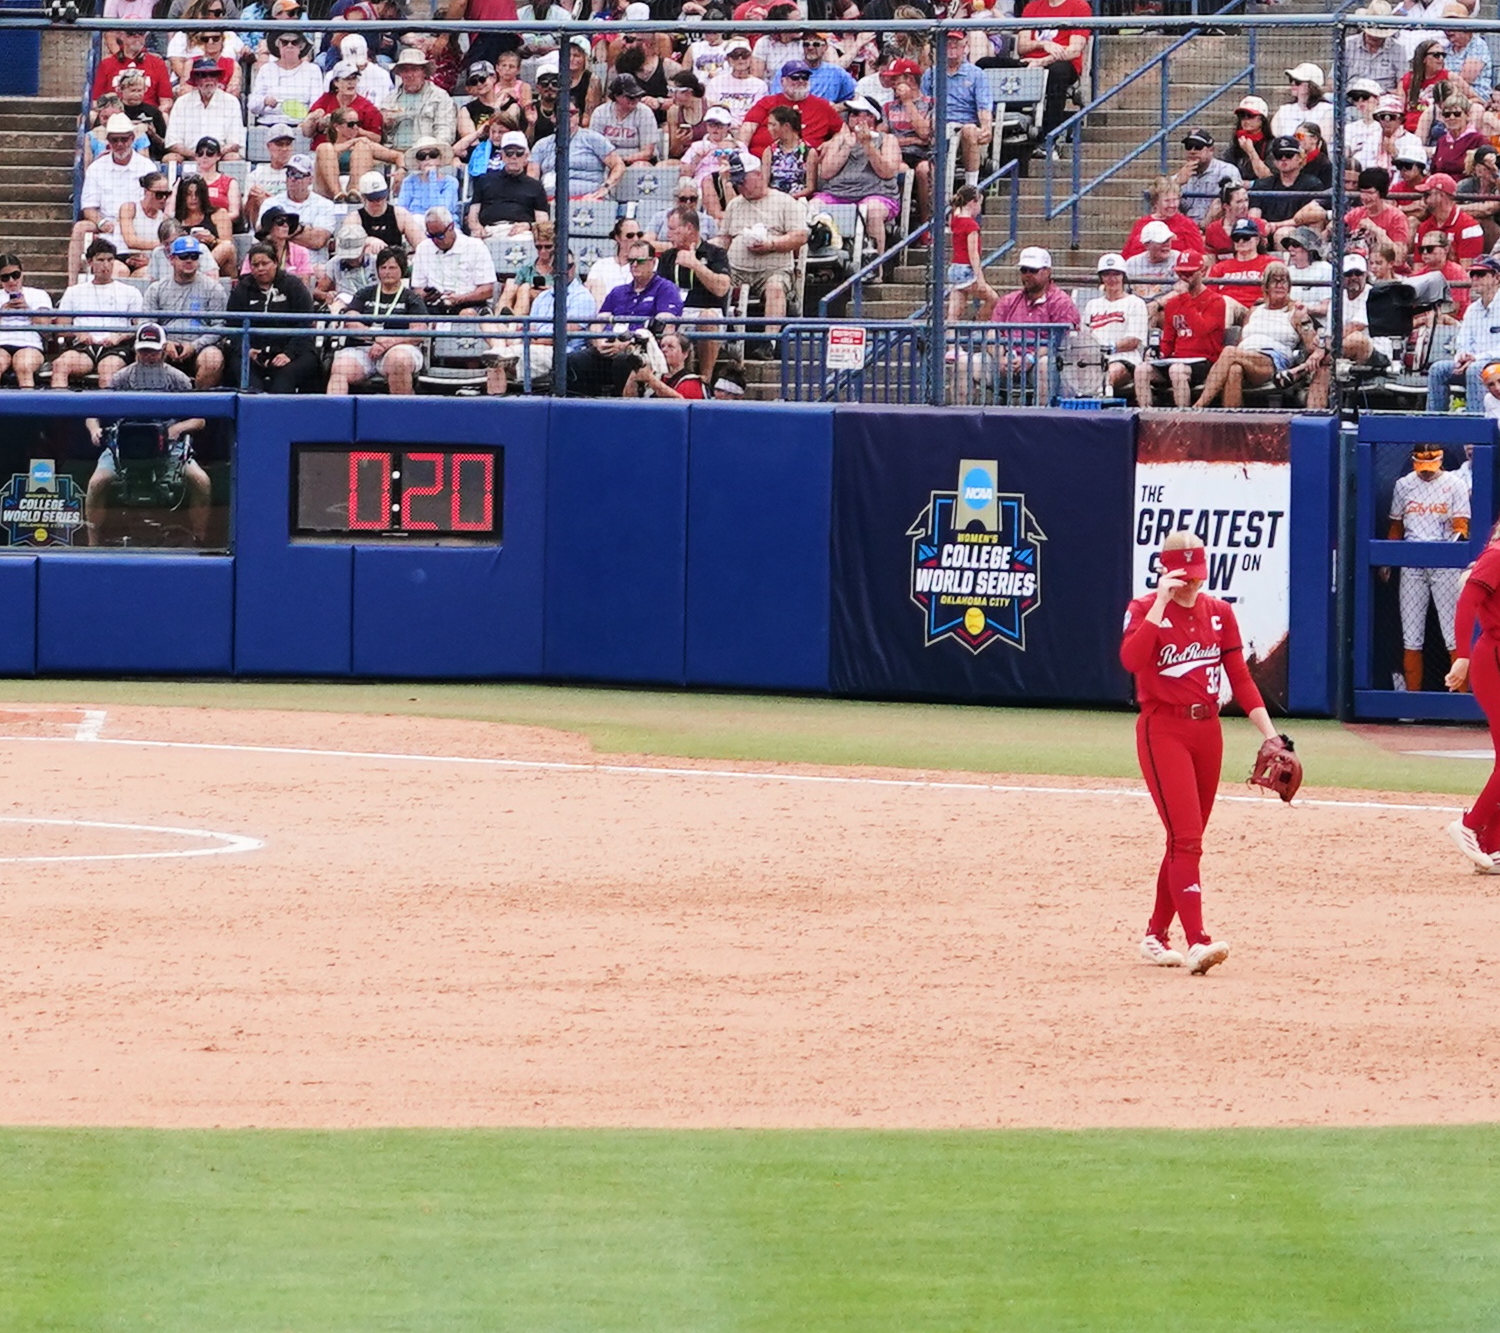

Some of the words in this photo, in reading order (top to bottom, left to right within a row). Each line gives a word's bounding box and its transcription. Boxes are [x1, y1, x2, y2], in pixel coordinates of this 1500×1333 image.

[964, 486, 993, 500] NCAA
[1140, 485, 1166, 503] THE
[18, 498, 66, 511] COLLEGE
[2, 509, 40, 522] WORLD
[41, 511, 80, 523] SERIES
[1136, 508, 1285, 549] GREATEST
[957, 533, 999, 544] WOMEN'S
[940, 543, 1013, 570] COLLEGE
[1145, 551, 1239, 591] SW
[1241, 553, 1262, 572] ON
[915, 568, 975, 593] WORLD
[974, 570, 1036, 597] SERIES
[940, 594, 988, 607] OKLAHOMA
[988, 597, 1011, 607] CITY
[1210, 615, 1223, 631] C
